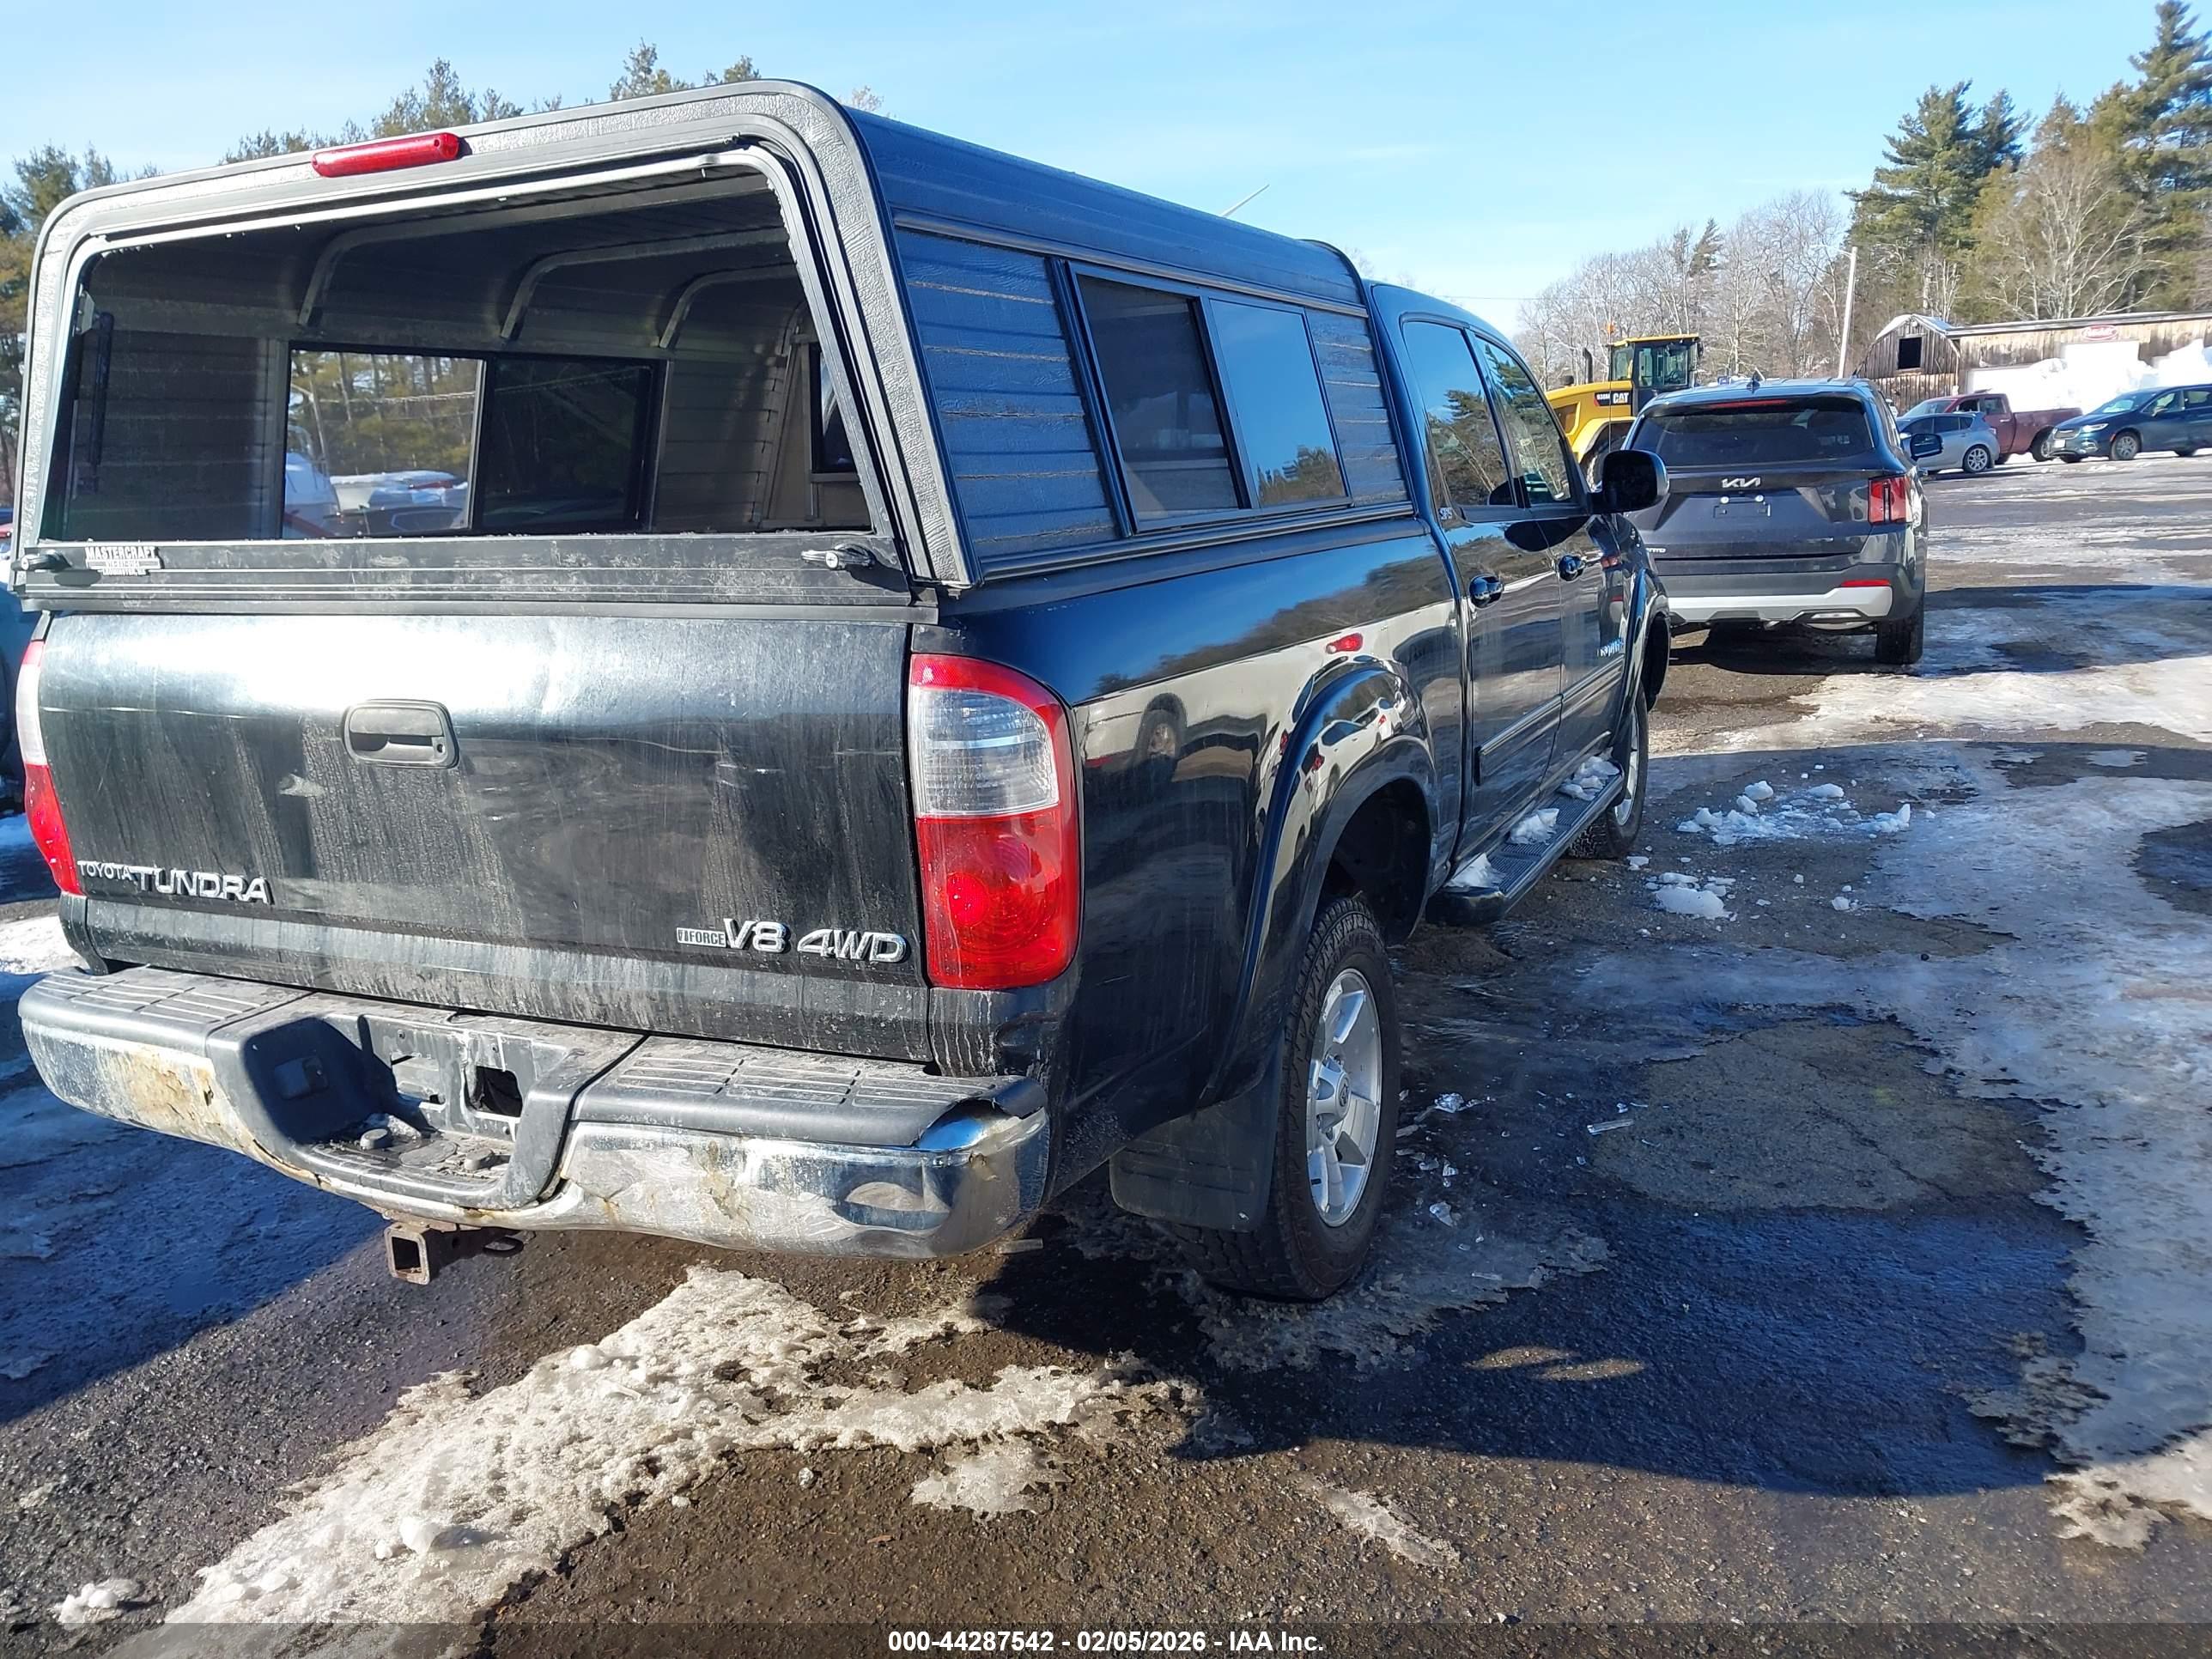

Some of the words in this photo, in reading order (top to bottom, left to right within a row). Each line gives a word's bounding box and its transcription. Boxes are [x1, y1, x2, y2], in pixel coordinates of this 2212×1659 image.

[1613, 392, 1630, 404] CAT
[1722, 477, 1761, 489] KIA
[84, 545, 156, 560] MASTERCRAFT
[76, 860, 132, 881] TOYOTA
[129, 865, 269, 904] TUNDRA
[723, 918, 786, 953] V8
[797, 928, 907, 963] 4WD
